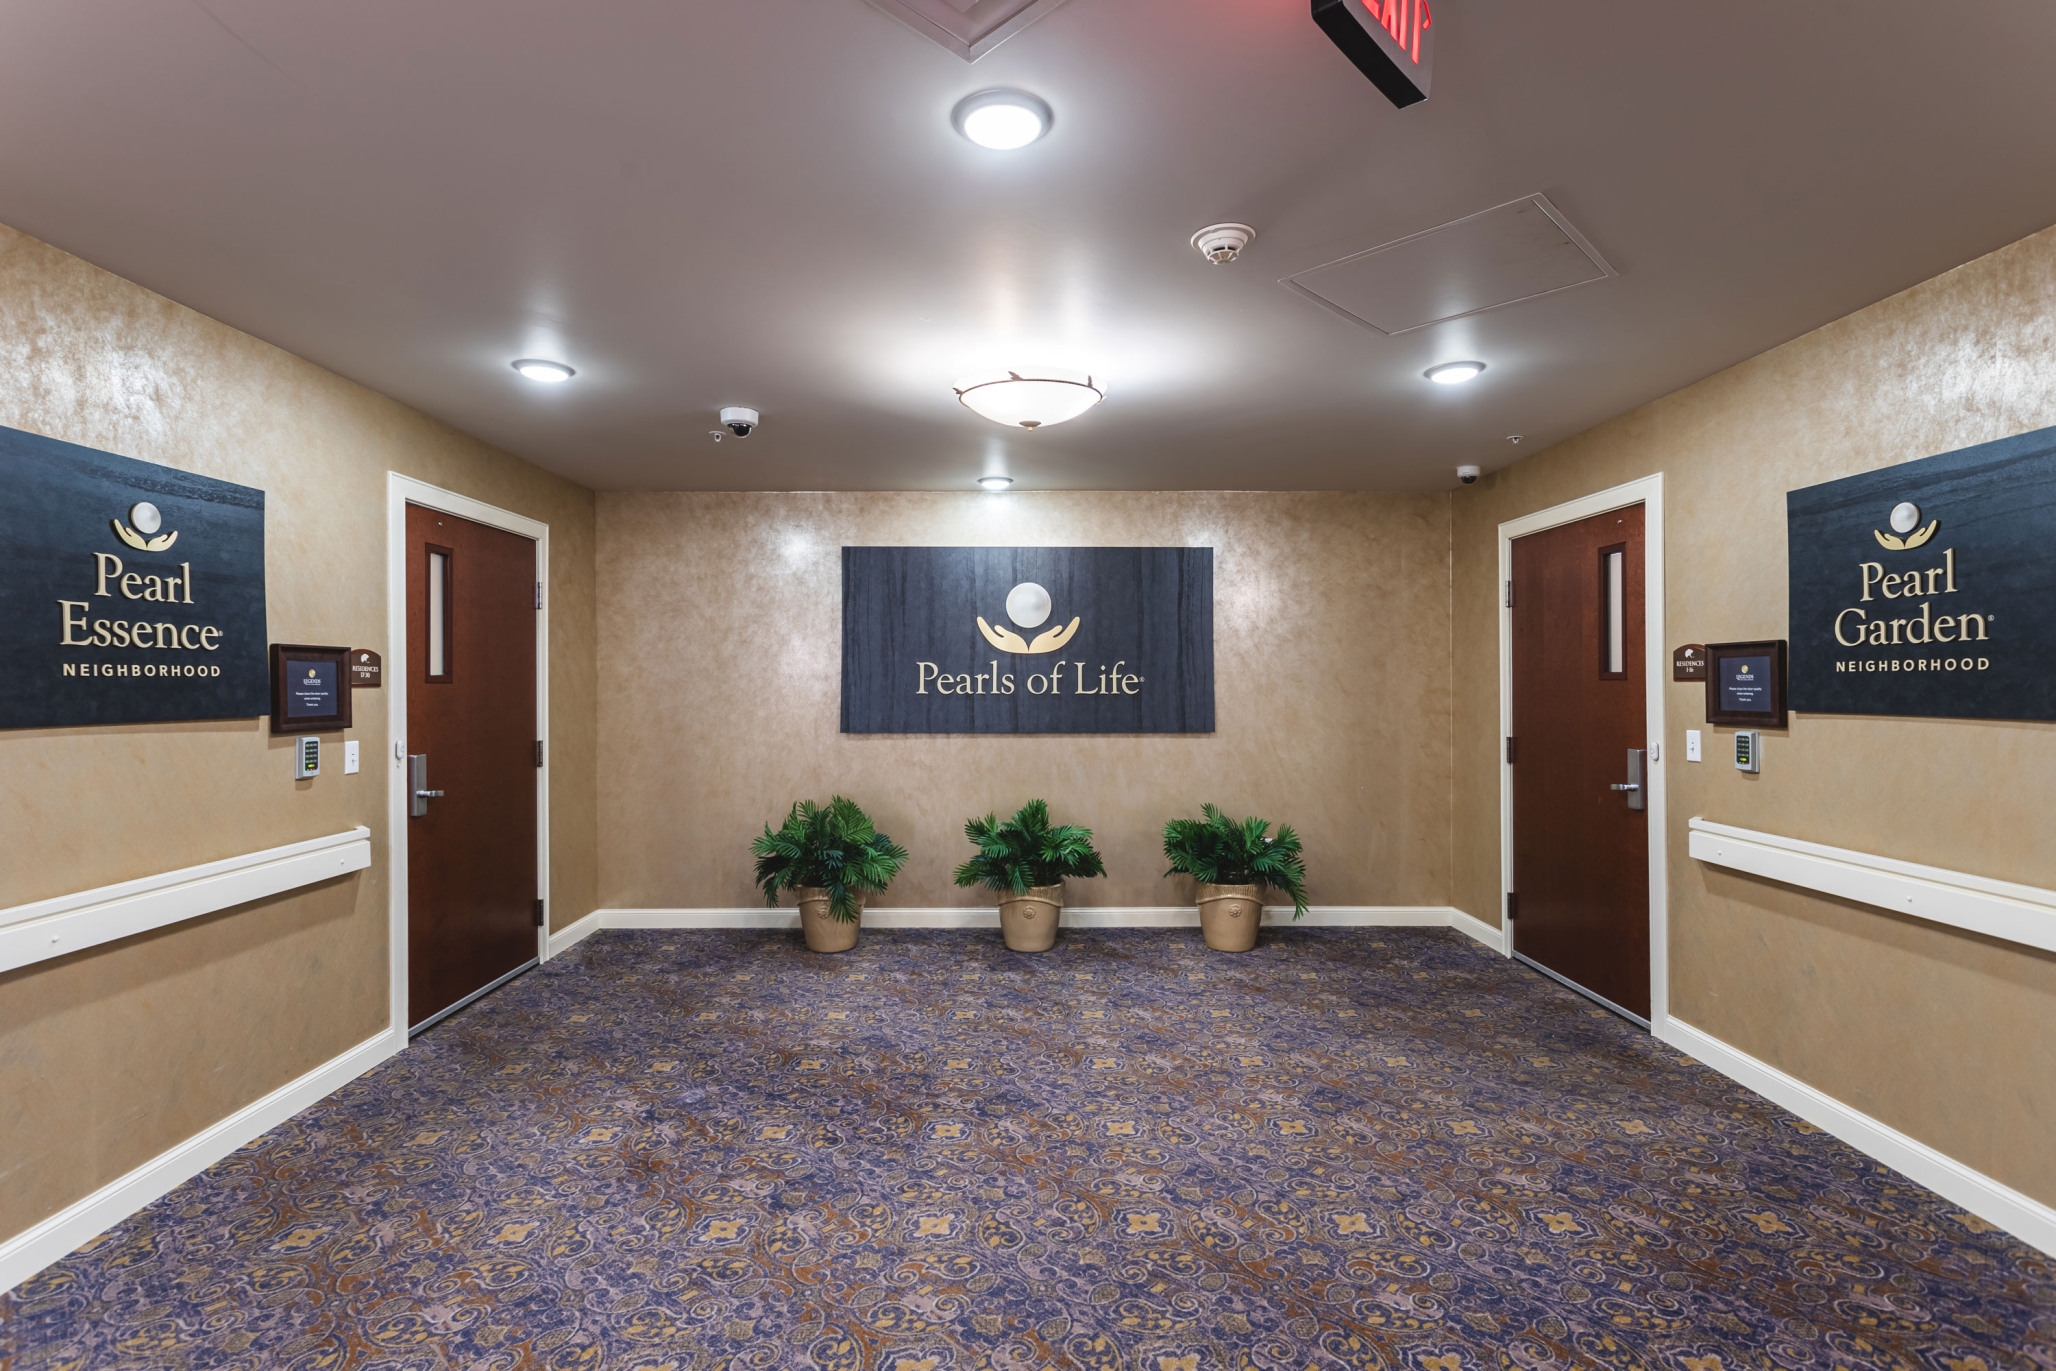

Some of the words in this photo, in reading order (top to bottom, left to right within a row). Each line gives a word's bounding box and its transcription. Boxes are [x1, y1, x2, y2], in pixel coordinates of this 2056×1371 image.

[93, 552, 195, 604] Pearl
[1858, 548, 1959, 602] Pearl
[62, 663, 221, 677] NEIGHBORHOOD
[915, 659, 1015, 695] Pearls
[1027, 660, 1066, 695] of
[1836, 658, 1990, 673] NEIGHBORHOOD
